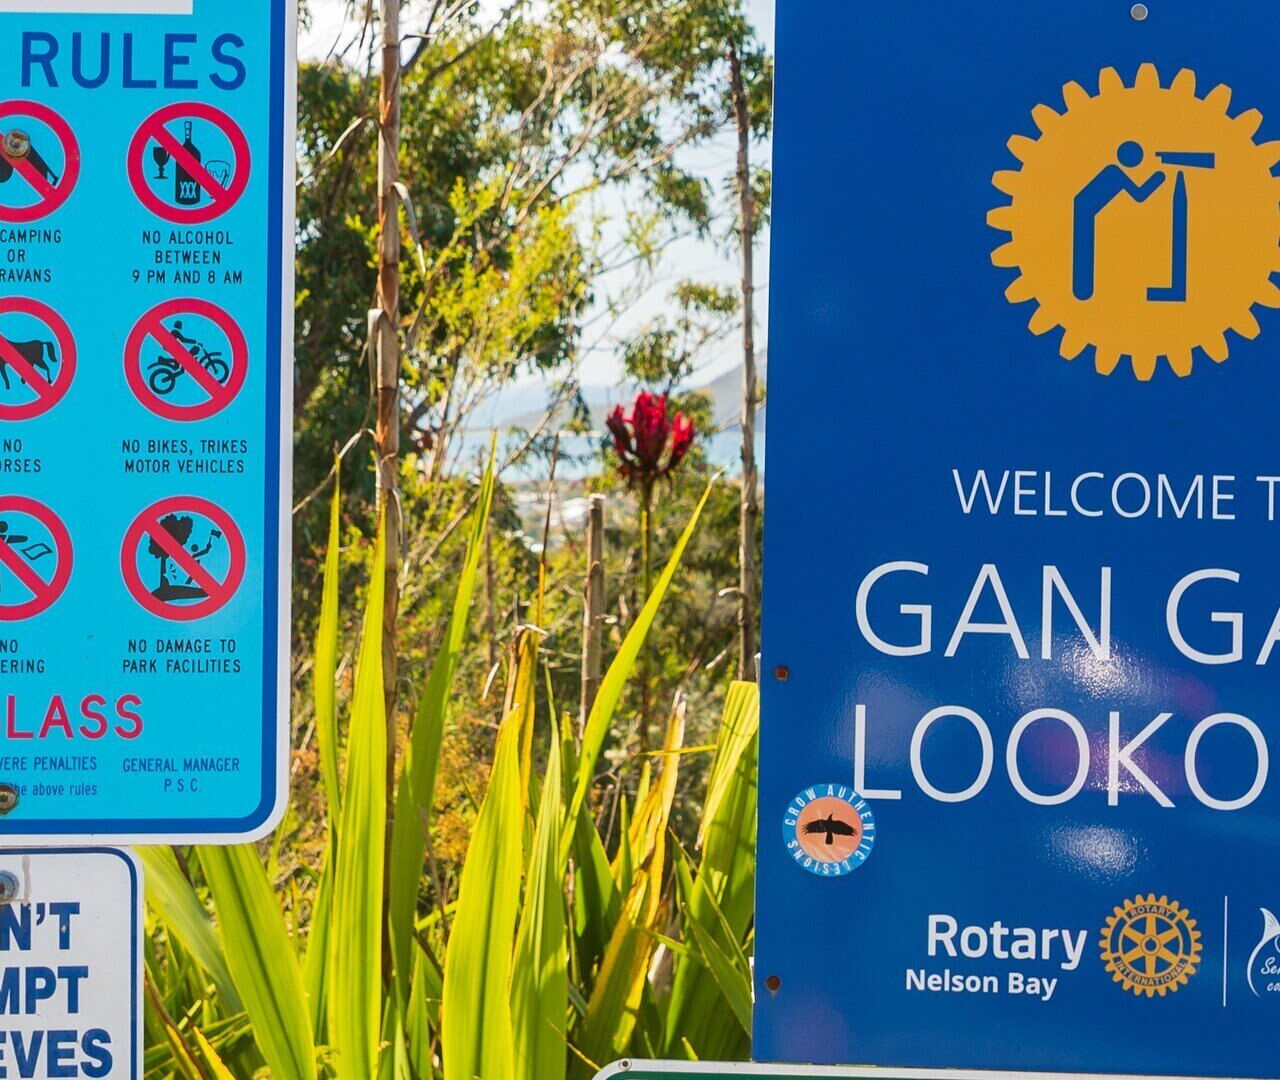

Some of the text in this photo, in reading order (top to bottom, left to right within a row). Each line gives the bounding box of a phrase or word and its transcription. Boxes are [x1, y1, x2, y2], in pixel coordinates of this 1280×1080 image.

[22, 32, 246, 90] RULES
[0, 229, 61, 243] CAMPING
[143, 231, 233, 244] NO ALCOHOL
[7, 249, 25, 262] OR
[155, 250, 220, 264] BETWEEN
[133, 270, 242, 283] 9 PM AND 8 AM
[4, 439, 21, 453] NO
[123, 440, 247, 456] NO BIKES, TRIKES
[125, 459, 243, 473] MOTOR VEHICLES
[953, 469, 1235, 519] WELCOME
[856, 561, 1112, 660] GAN
[0, 640, 18, 653] NO
[129, 639, 235, 653] NO DAMAGE TO
[123, 659, 240, 673] PARK FACILITIES
[34, 757, 96, 770] PENALTIES
[123, 758, 239, 772] GENERAL MANAGER
[33, 783, 64, 796] above
[70, 783, 97, 795] rules
[785, 784, 874, 874] CROW AUTHENTIC DESIGNS
[1130, 906, 1172, 917] ROTARY
[927, 915, 1087, 969] Rotary
[1116, 960, 1186, 986] INTERNATIONAL
[906, 969, 1057, 1001] Nelson Bay
